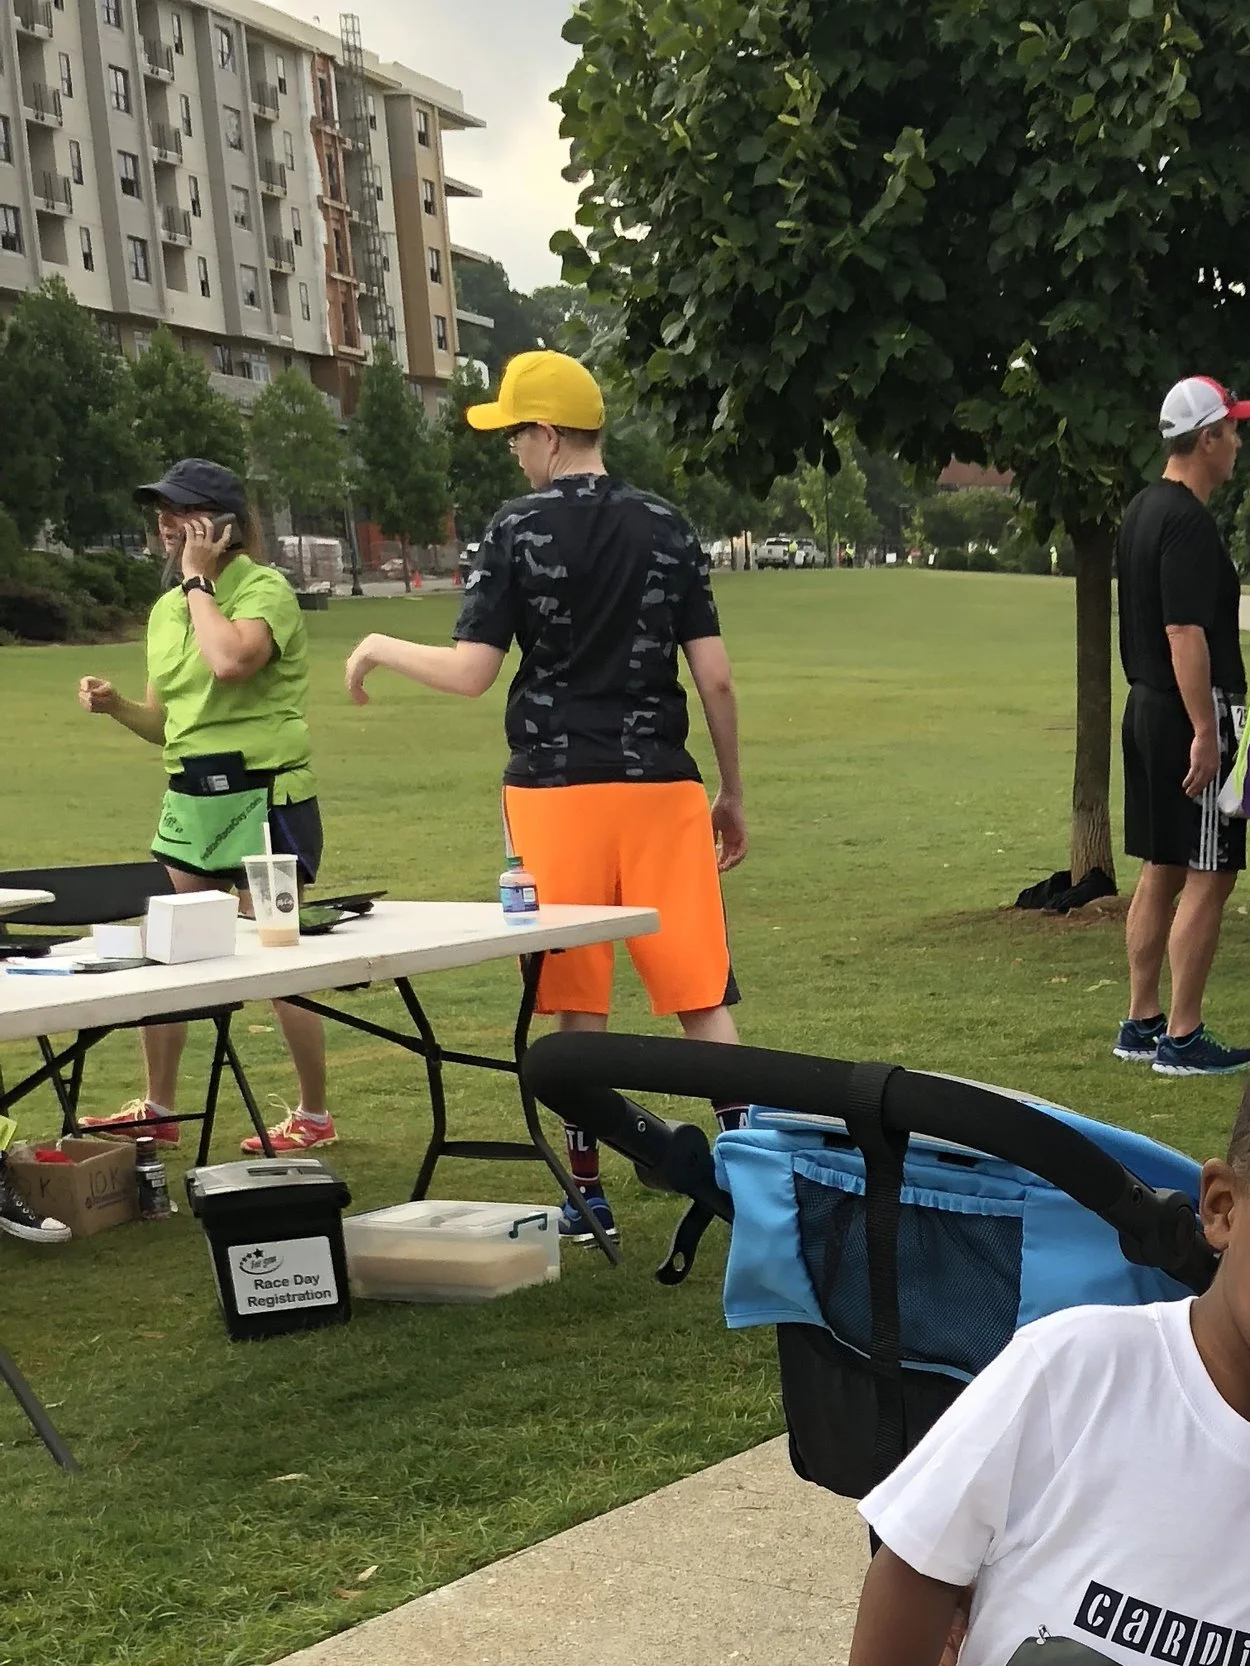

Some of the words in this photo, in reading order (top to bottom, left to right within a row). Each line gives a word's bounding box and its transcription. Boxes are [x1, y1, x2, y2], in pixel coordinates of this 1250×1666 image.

[253, 1278, 290, 1291] Race
[293, 1274, 320, 1286] Day
[247, 1289, 332, 1308] Registration
